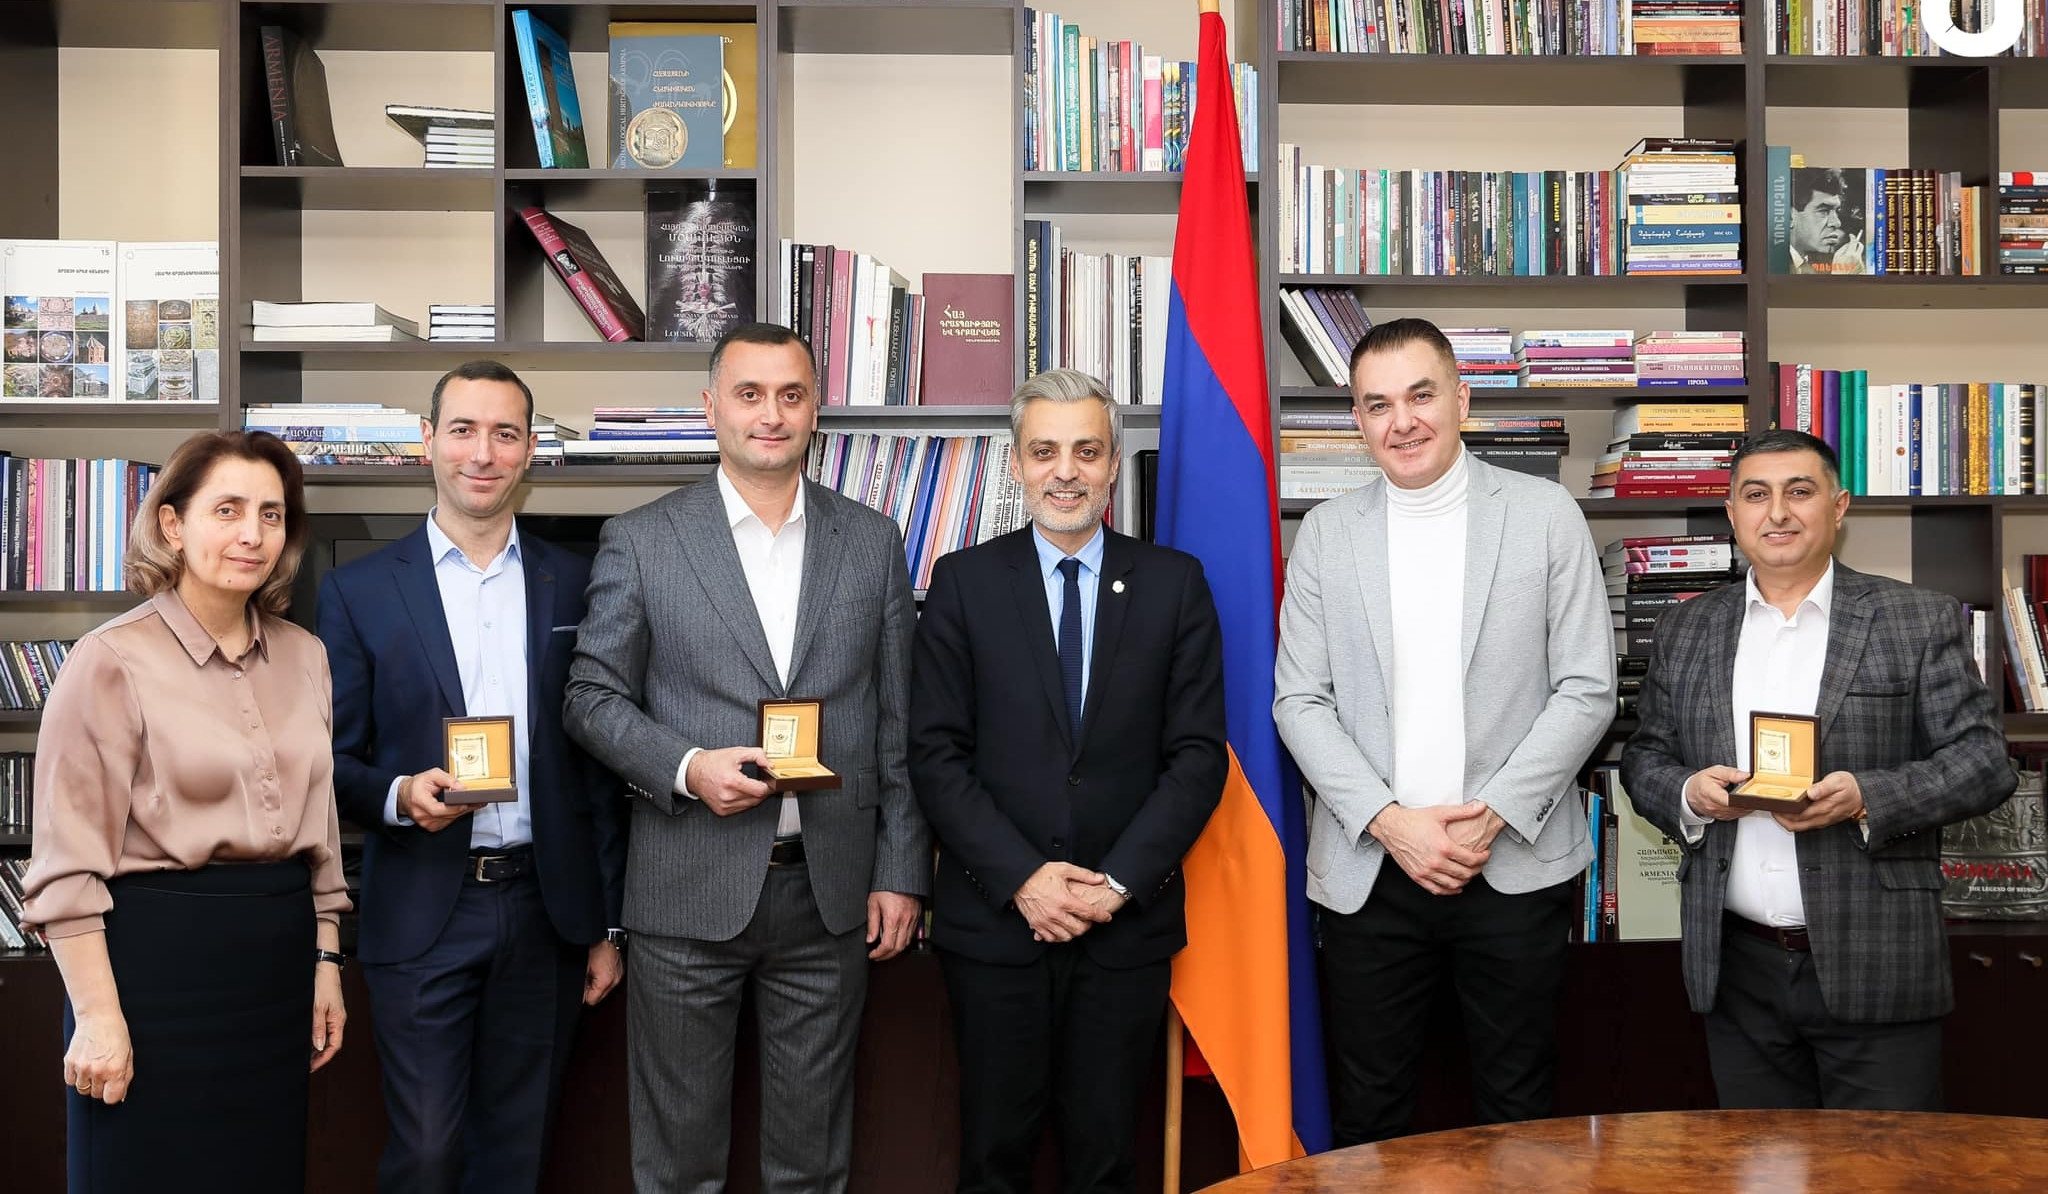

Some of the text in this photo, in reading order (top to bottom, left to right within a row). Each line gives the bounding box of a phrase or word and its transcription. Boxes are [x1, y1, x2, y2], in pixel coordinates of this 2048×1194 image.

[263, 35, 288, 121] ARMENIA
[1541, 420, 1562, 428] ШТАТЫ
[316, 442, 372, 454] АРМЕНИЯ
[1941, 860, 2034, 881] ARMENIA
[1982, 885, 2005, 893] LEGEND
